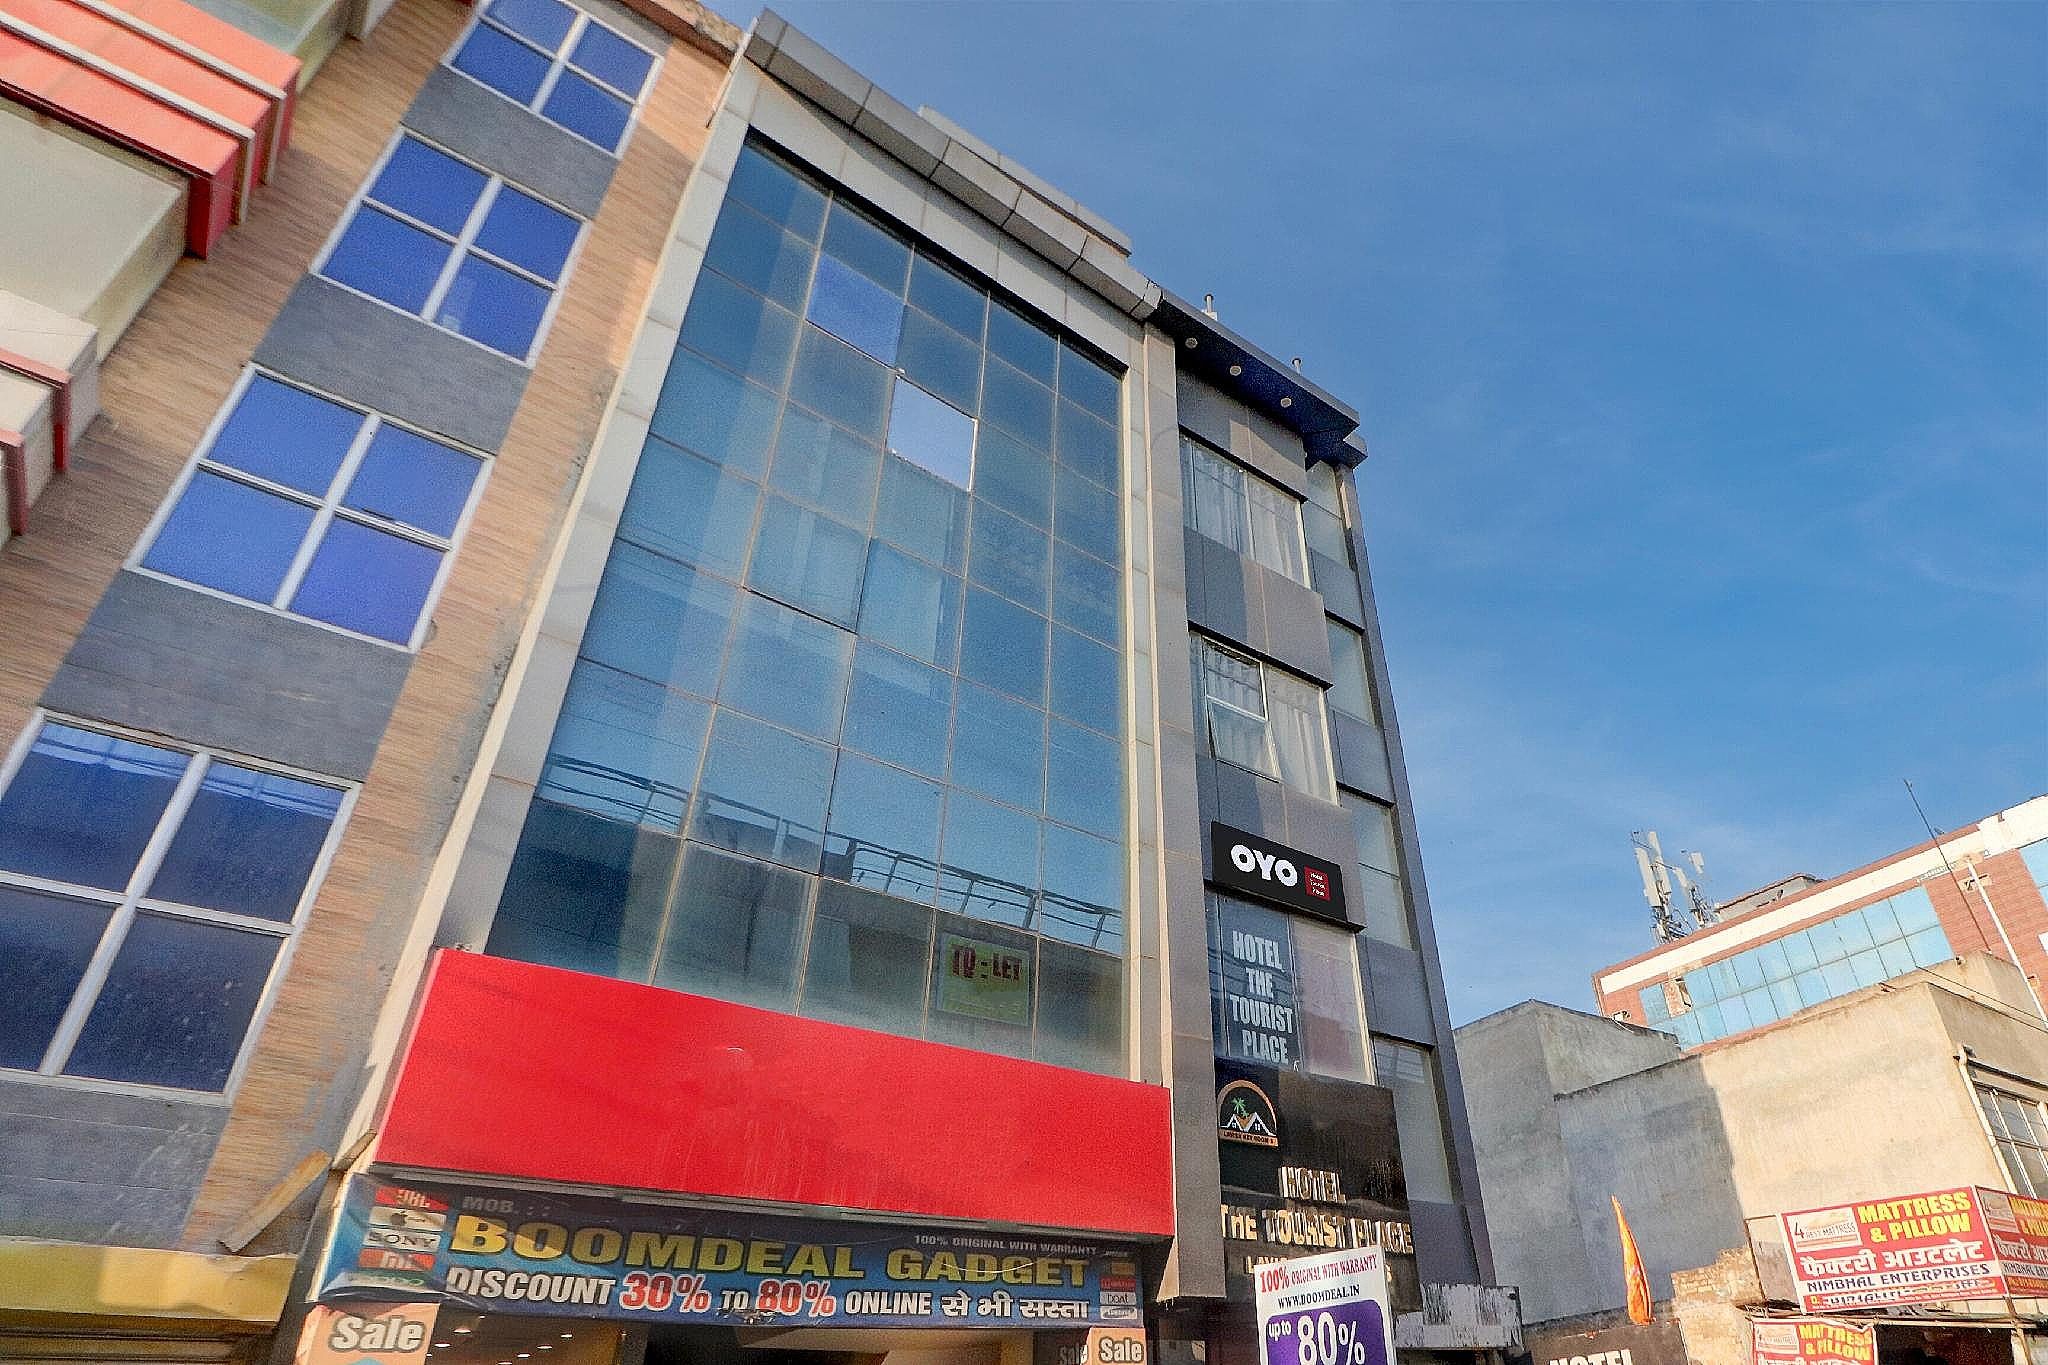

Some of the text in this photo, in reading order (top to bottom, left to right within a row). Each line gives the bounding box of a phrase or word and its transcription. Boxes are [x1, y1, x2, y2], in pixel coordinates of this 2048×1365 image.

[1231, 844, 1297, 886] OYO
[1233, 930, 1283, 970] HOTEL
[1246, 967, 1273, 999] THE
[1230, 995, 1293, 1034] TOURIST
[1242, 1029, 1288, 1064] PLACE
[1279, 1167, 1346, 1203] HOTEL
[1857, 1191, 1972, 1224] MATTRESS
[368, 1231, 436, 1248] SONY
[1262, 1209, 1346, 1248] TOURIST
[1870, 1213, 1971, 1243] & PILLOW
[451, 1215, 1090, 1288] BOOMDEAL GADGET
[1009, 1241, 1037, 1252] WITH
[1260, 1254, 1377, 1293] 100% ORIGINAL WITH WARRANTY
[1807, 1276, 1876, 1293] NIMBHAL
[1881, 1263, 1990, 1285] ENTERPRISES
[446, 1267, 616, 1305] DISCOUNT
[620, 1271, 712, 1313] 30%
[721, 1290, 749, 1310] TO
[757, 1279, 837, 1317] 80%
[845, 1290, 932, 1315] ONLINE
[942, 1290, 971, 1316] से
[977, 1290, 1013, 1317] भी
[1019, 1298, 1089, 1319] सस्ता
[331, 1316, 424, 1350] Sale
[1100, 1338, 1142, 1362] Sale
[1298, 1312, 1366, 1365] 80%
